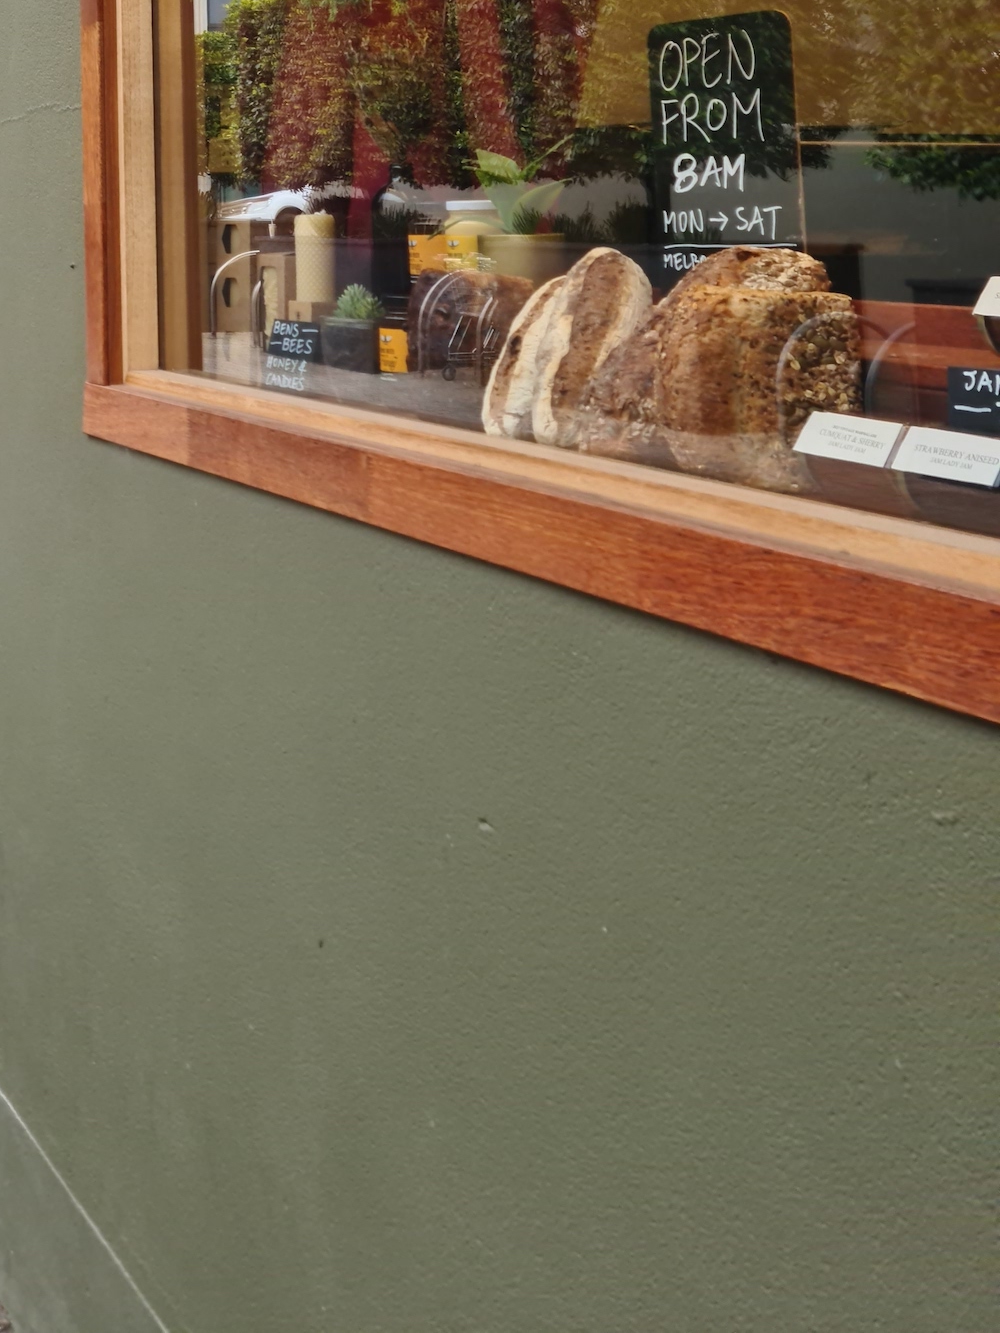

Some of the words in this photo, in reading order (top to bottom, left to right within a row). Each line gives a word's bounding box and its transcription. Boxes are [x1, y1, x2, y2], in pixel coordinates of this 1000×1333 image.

[659, 29, 755, 92] OPEN
[661, 88, 764, 145] FROM
[673, 153, 745, 193] 8AM
[663, 208, 704, 234] MON
[736, 206, 782, 240] SAT
[273, 320, 299, 337] BENS
[281, 337, 313, 354] BEES
[266, 355, 299, 372] HONEY
[265, 372, 305, 391] CANDLES
[819, 428, 851, 443] CUMQUAT
[858, 437, 886, 450] SHERRY
[914, 444, 965, 459] STRAWBERRY
[964, 453, 1000, 465] ANISEED
